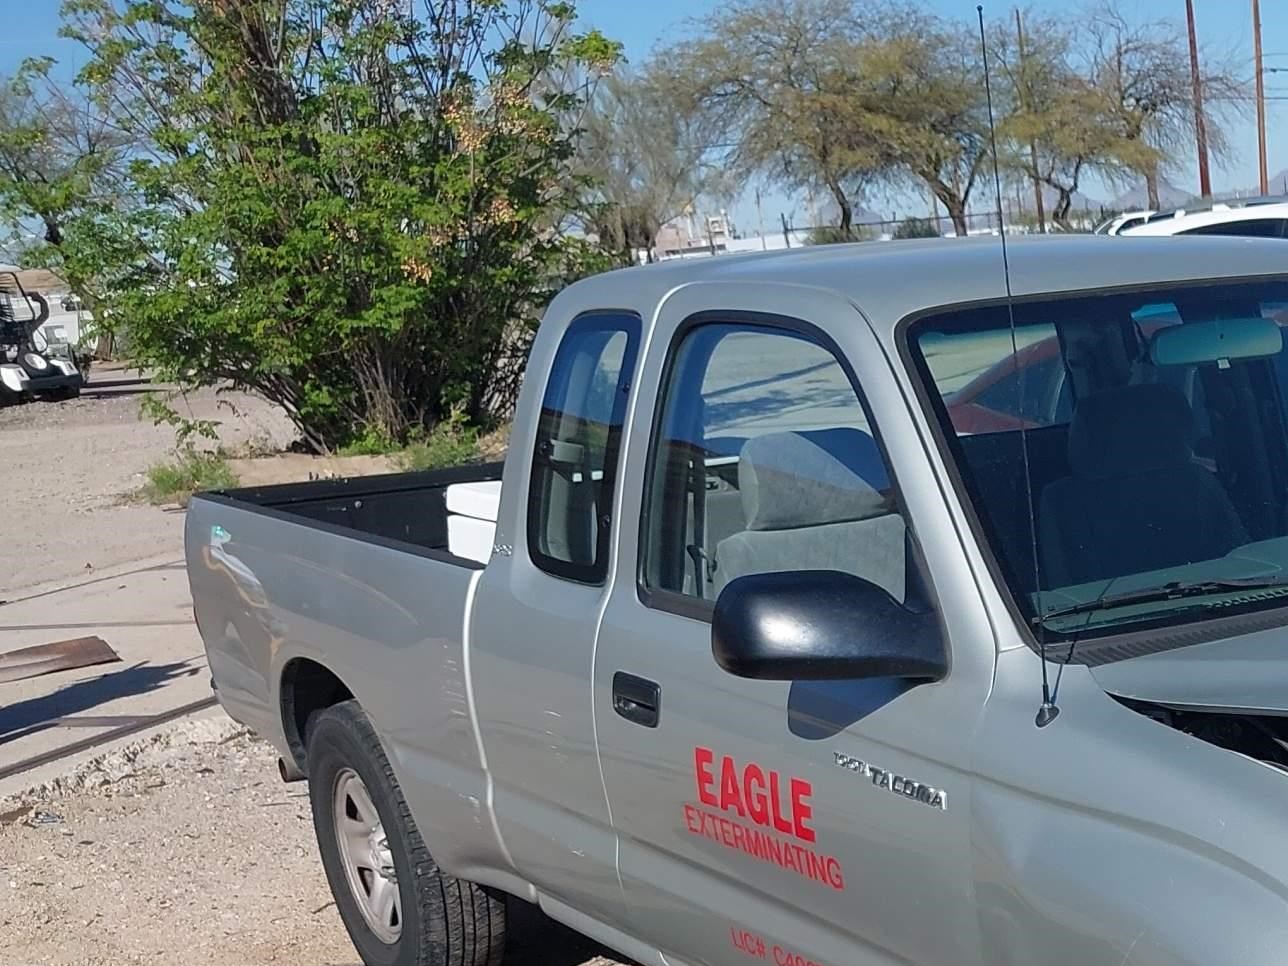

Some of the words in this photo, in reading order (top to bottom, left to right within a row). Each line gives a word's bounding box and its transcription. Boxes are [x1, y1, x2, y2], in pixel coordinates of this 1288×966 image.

[694, 746, 817, 843] EAGLE
[869, 765, 948, 811] TACOMA
[683, 803, 845, 891] EXTERMINATING
[729, 925, 767, 960] LIC#
